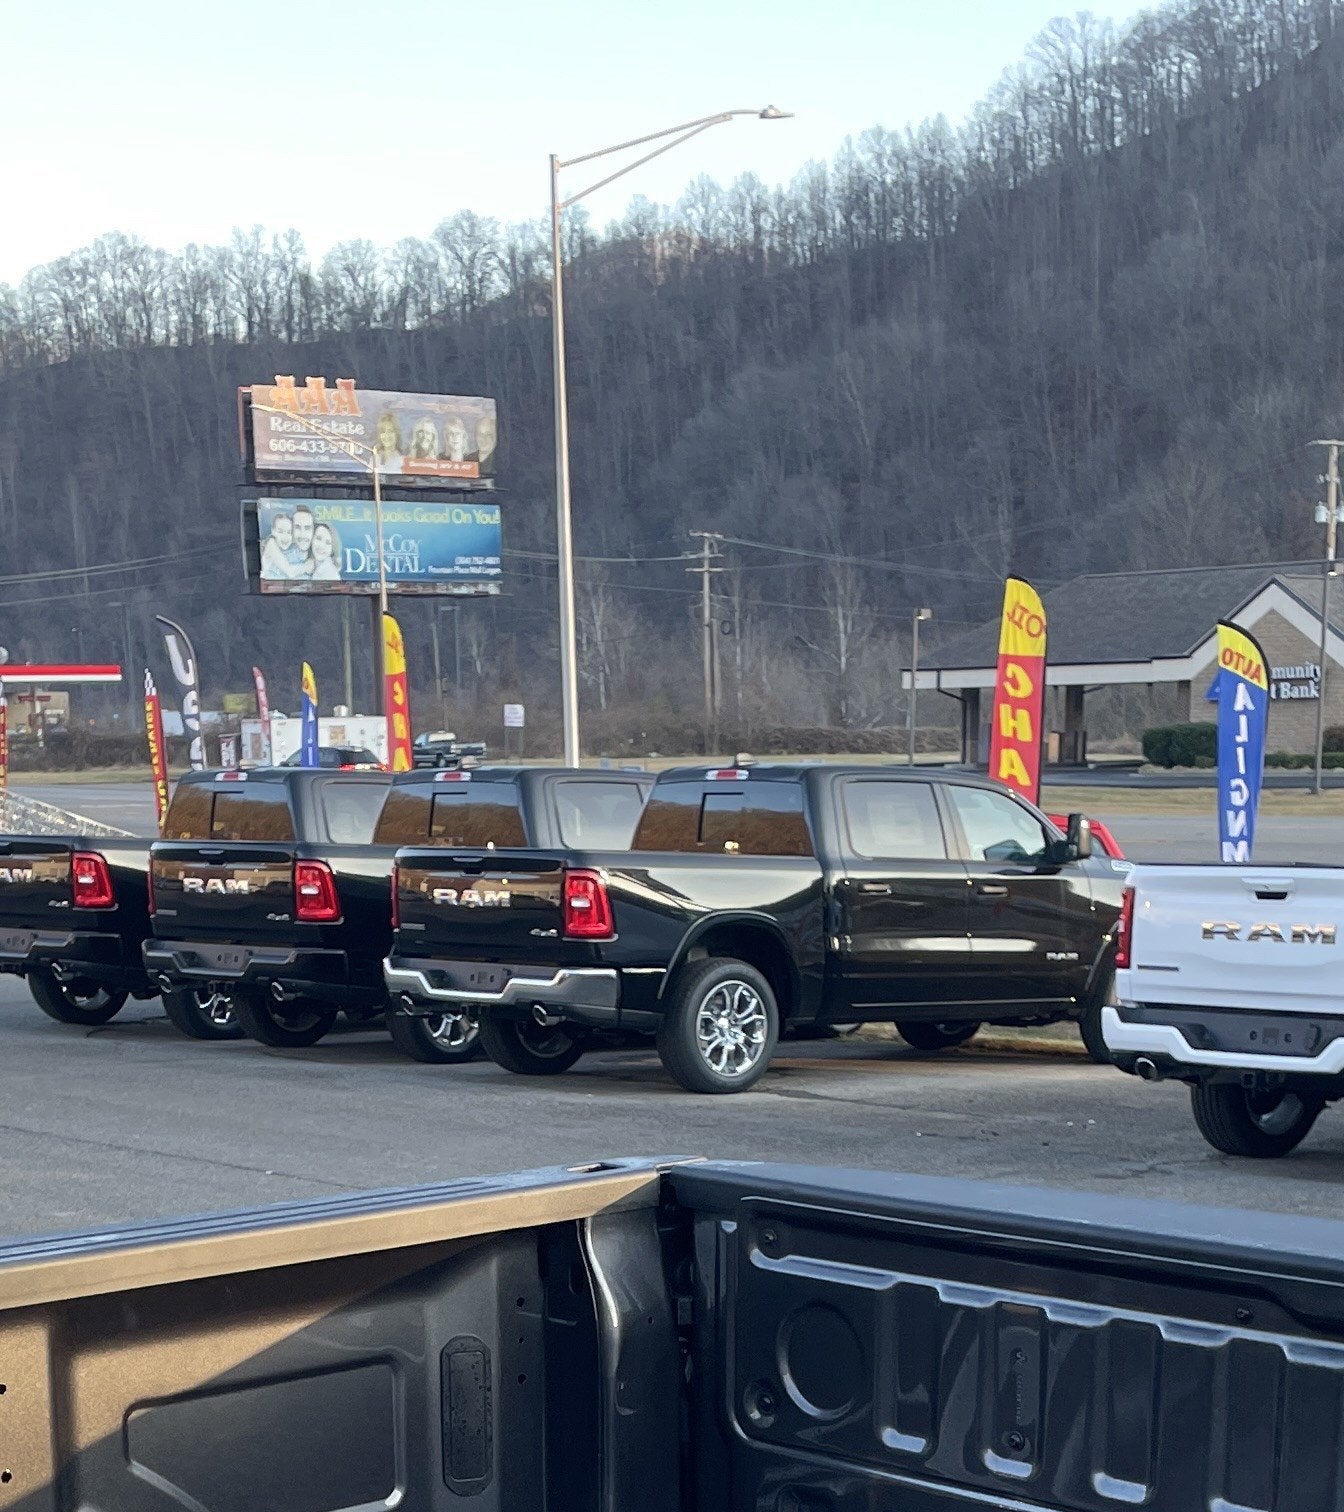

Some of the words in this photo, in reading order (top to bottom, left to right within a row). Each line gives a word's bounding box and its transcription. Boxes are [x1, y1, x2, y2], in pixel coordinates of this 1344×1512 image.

[379, 510, 411, 523] ooks
[413, 509, 450, 524] Good
[452, 509, 473, 525] On
[1270, 660, 1322, 682] munity
[1280, 680, 1320, 699] Bank
[183, 877, 249, 895] RAM
[433, 888, 511, 908] RAM
[1201, 921, 1338, 945] RAM
